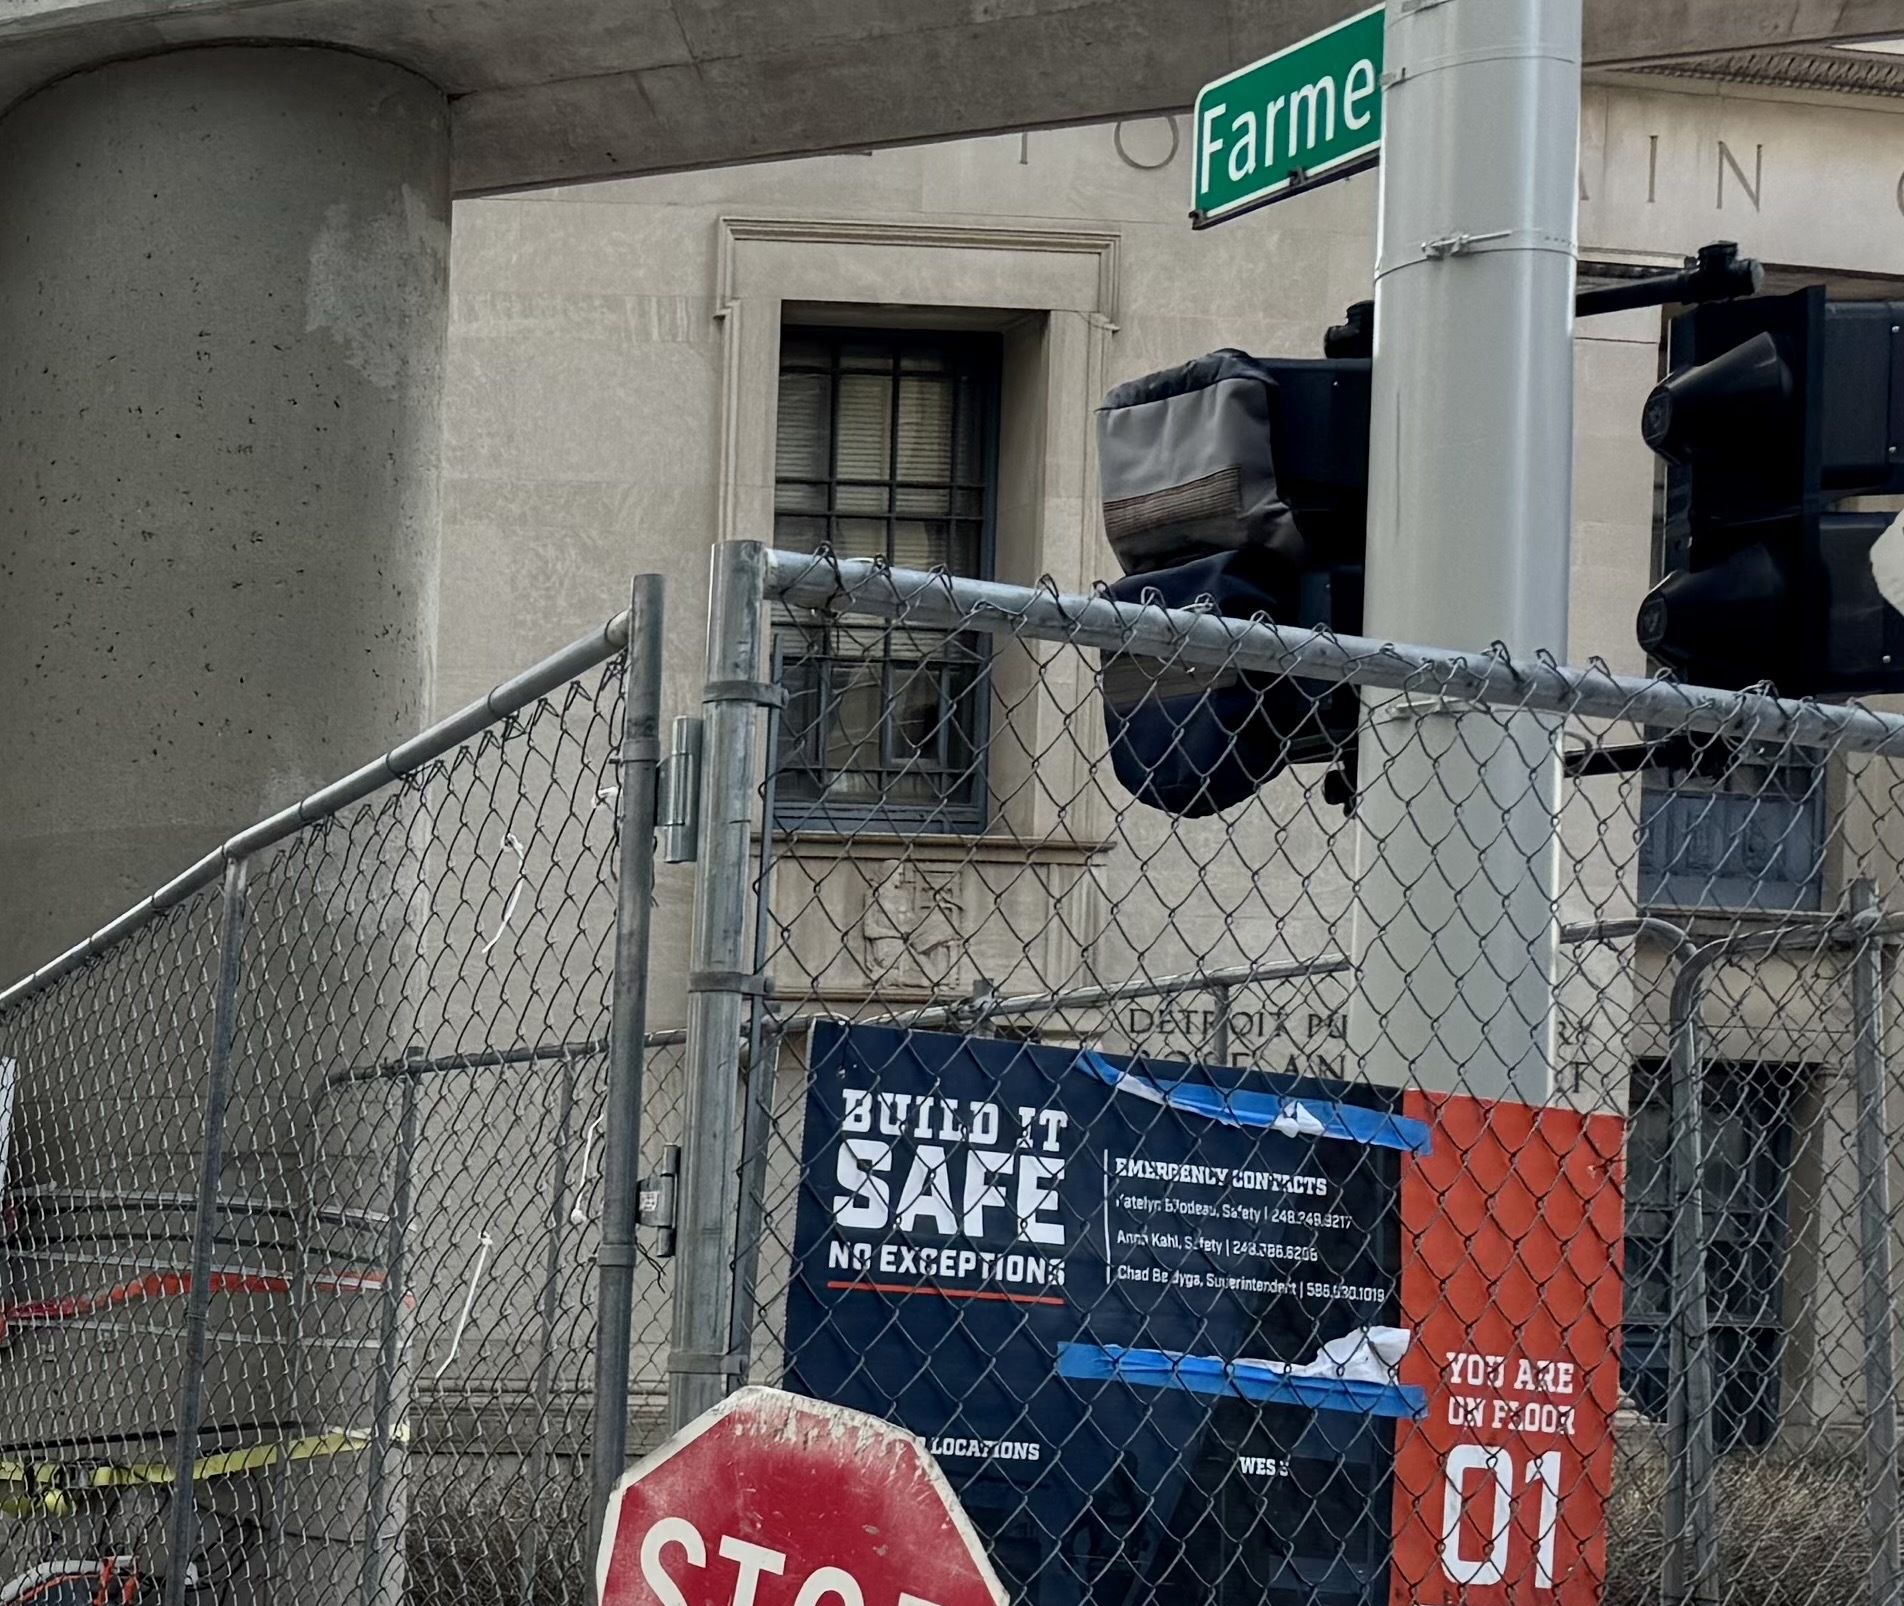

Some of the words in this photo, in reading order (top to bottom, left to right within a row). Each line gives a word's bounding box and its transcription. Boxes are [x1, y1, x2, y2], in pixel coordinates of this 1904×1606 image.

[842, 1088, 999, 1145] BUILD
[1017, 1106, 1068, 1151] IT
[833, 1138, 1065, 1244] SAFE
[1115, 1157, 1228, 1187] EMERGENCY
[1232, 1169, 1328, 1196] CONTACTS
[828, 1240, 872, 1271] NO
[880, 1245, 1065, 1286] EXCEPTIONS
[1117, 1264, 1150, 1281] Chad
[1445, 1352, 1505, 1388] YOU
[1514, 1359, 1575, 1394] ARE
[1448, 1396, 1487, 1428] ON
[1491, 1400, 1575, 1435] FLOOR
[931, 1437, 1040, 1460] LOCATIONS
[1442, 1444, 1562, 1588] 01
